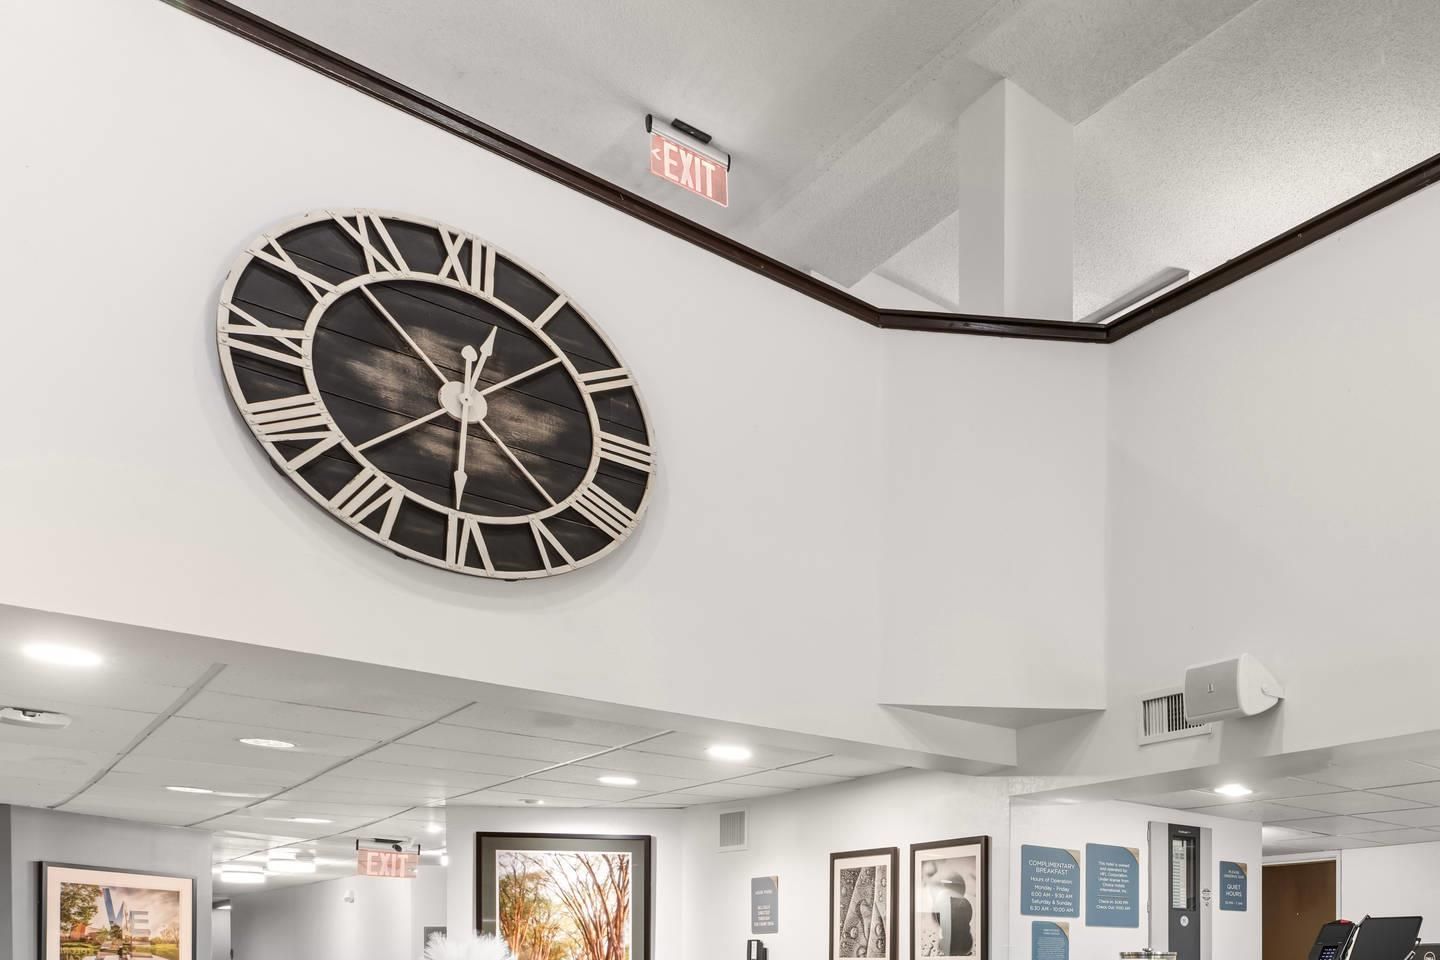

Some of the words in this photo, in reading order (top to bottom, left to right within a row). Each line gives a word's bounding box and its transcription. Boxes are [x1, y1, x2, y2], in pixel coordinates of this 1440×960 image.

[664, 141, 715, 197] EXIT
[367, 852, 408, 878] EXIT
[1028, 860, 1074, 869] COMPLIMENTARY
